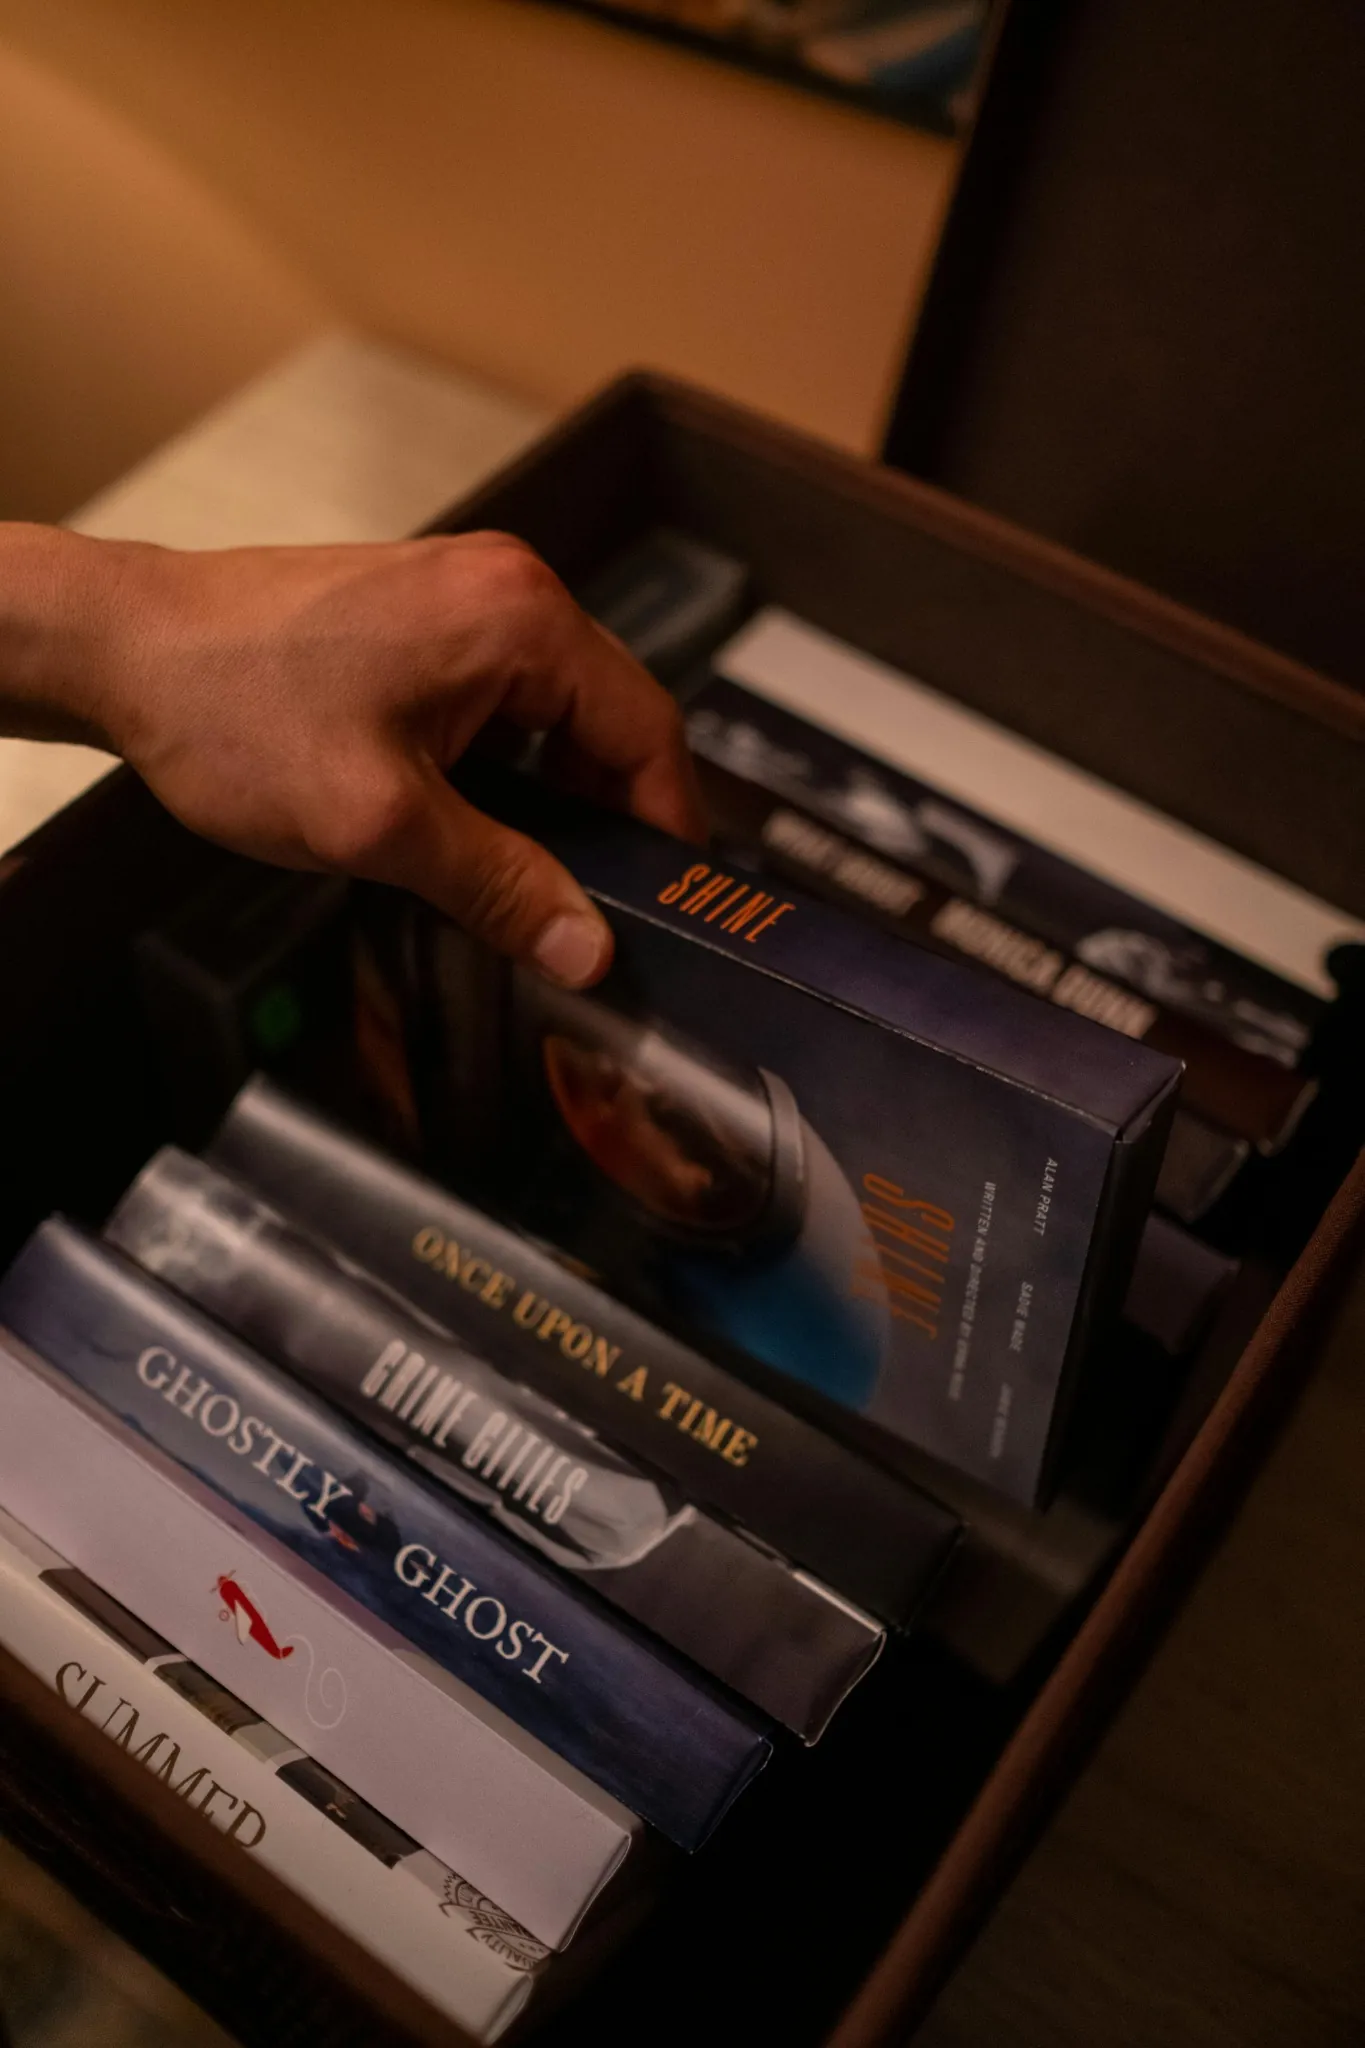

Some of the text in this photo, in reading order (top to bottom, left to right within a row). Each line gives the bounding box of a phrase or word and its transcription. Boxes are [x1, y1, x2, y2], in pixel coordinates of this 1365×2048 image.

[657, 863, 796, 943] SHINE
[976, 1181, 996, 1236] WRITTEN
[1033, 1157, 1058, 1236] ALAN PRATT
[850, 1173, 954, 1341] SHINE
[972, 1237, 987, 1262] AND
[411, 1226, 759, 1468] ONCE UPON A TIME
[136, 1345, 570, 1685] GHOSTLY GHOST
